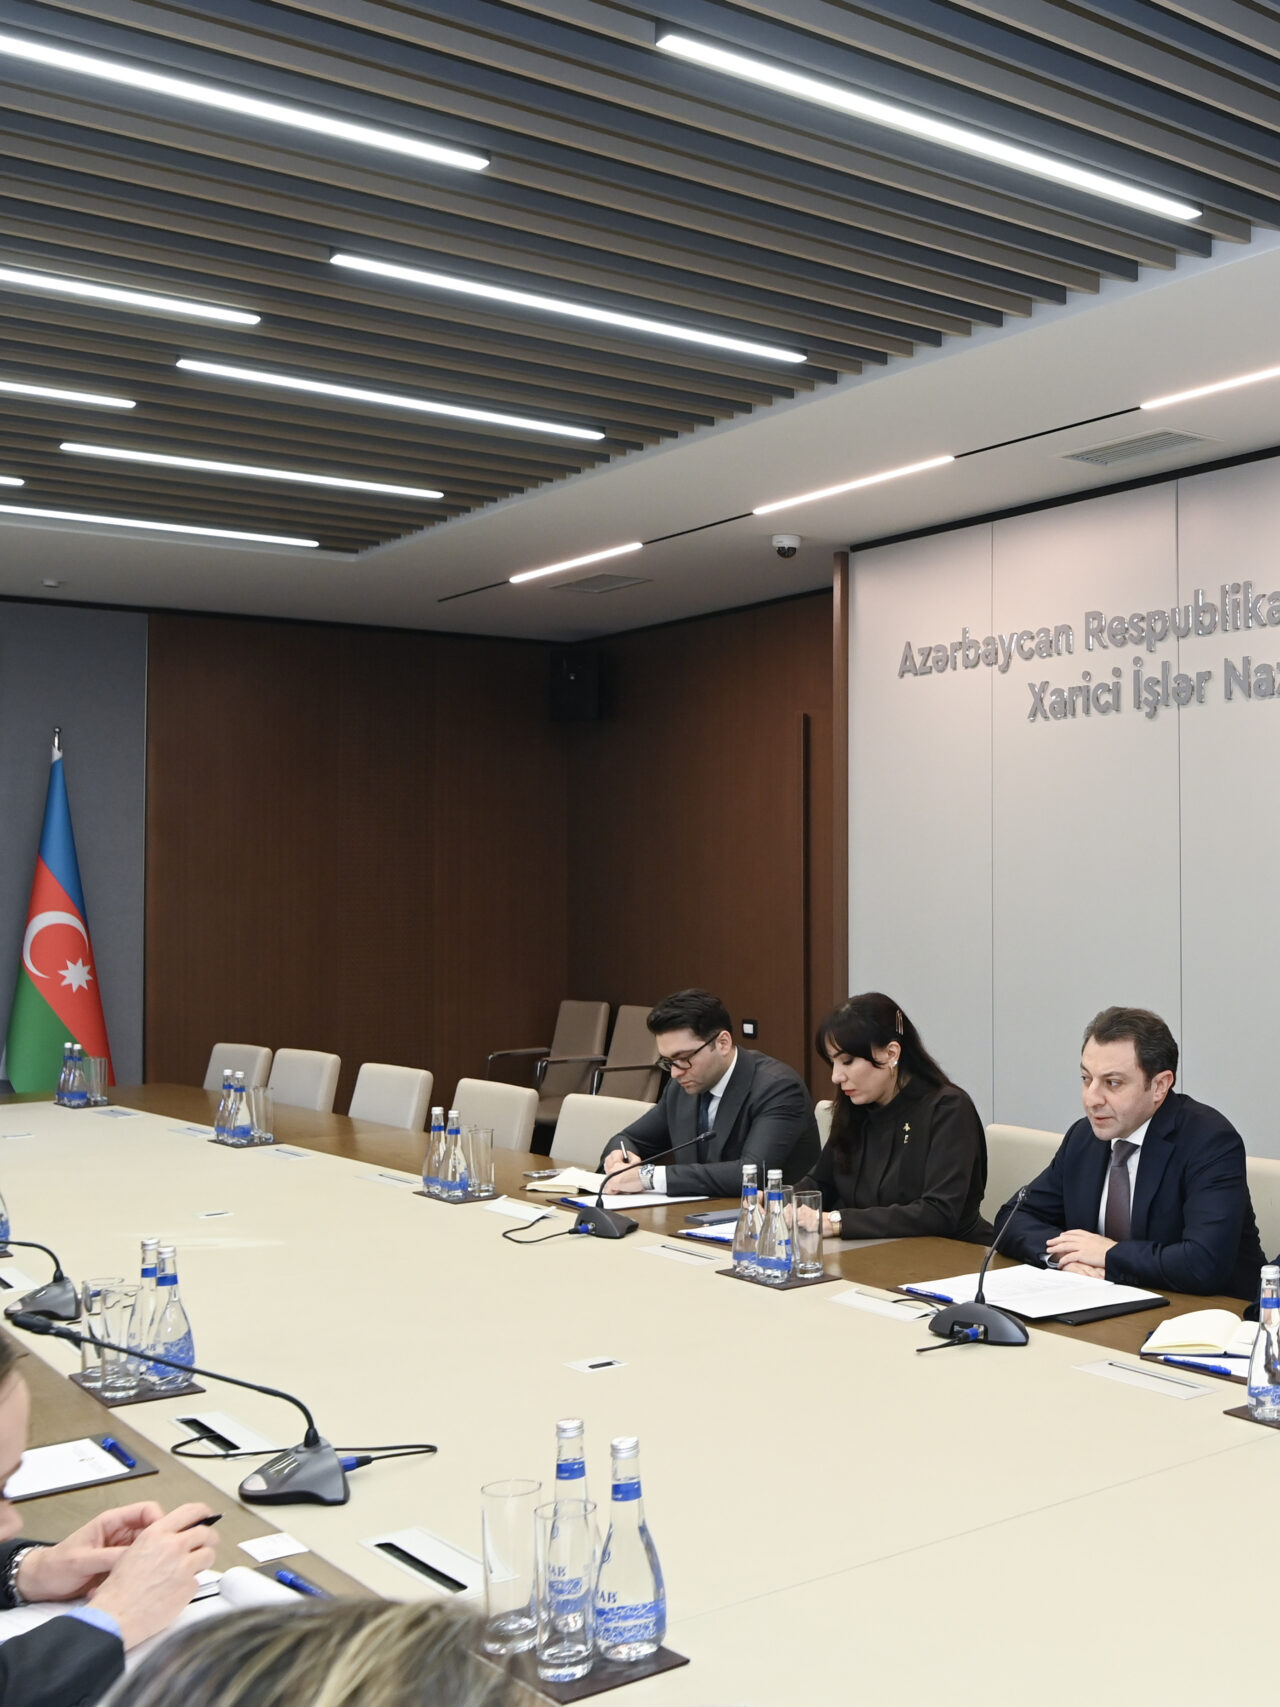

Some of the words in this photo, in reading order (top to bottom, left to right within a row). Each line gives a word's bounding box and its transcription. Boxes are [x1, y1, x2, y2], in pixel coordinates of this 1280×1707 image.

[898, 623, 1075, 679] Azərbaycan
[1027, 666, 1123, 723] Xarici
[1132, 655, 1212, 719] İşlər
